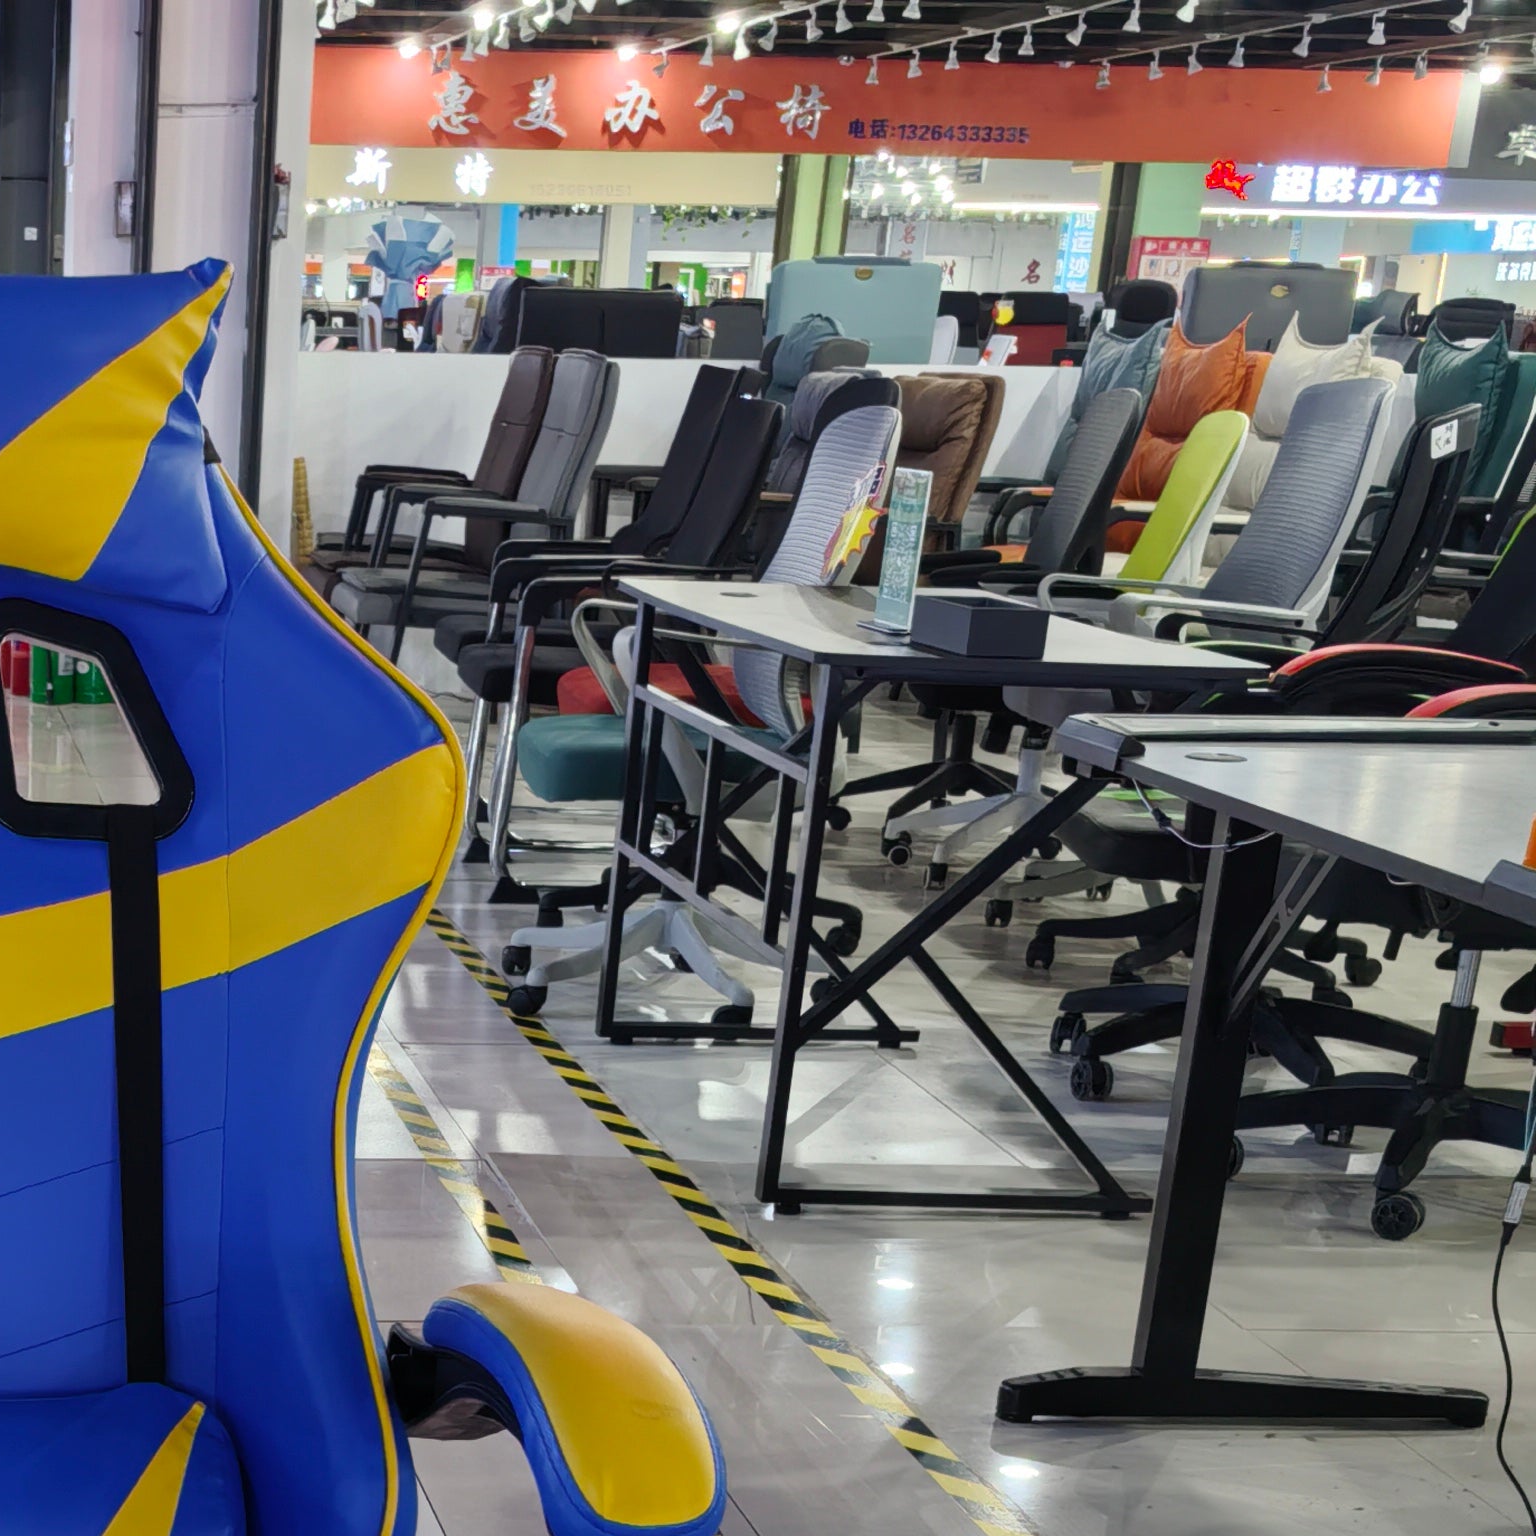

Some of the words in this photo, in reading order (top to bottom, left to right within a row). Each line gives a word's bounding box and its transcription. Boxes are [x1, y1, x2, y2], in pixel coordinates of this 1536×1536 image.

[427, 70, 832, 140] 惠美办公椅
